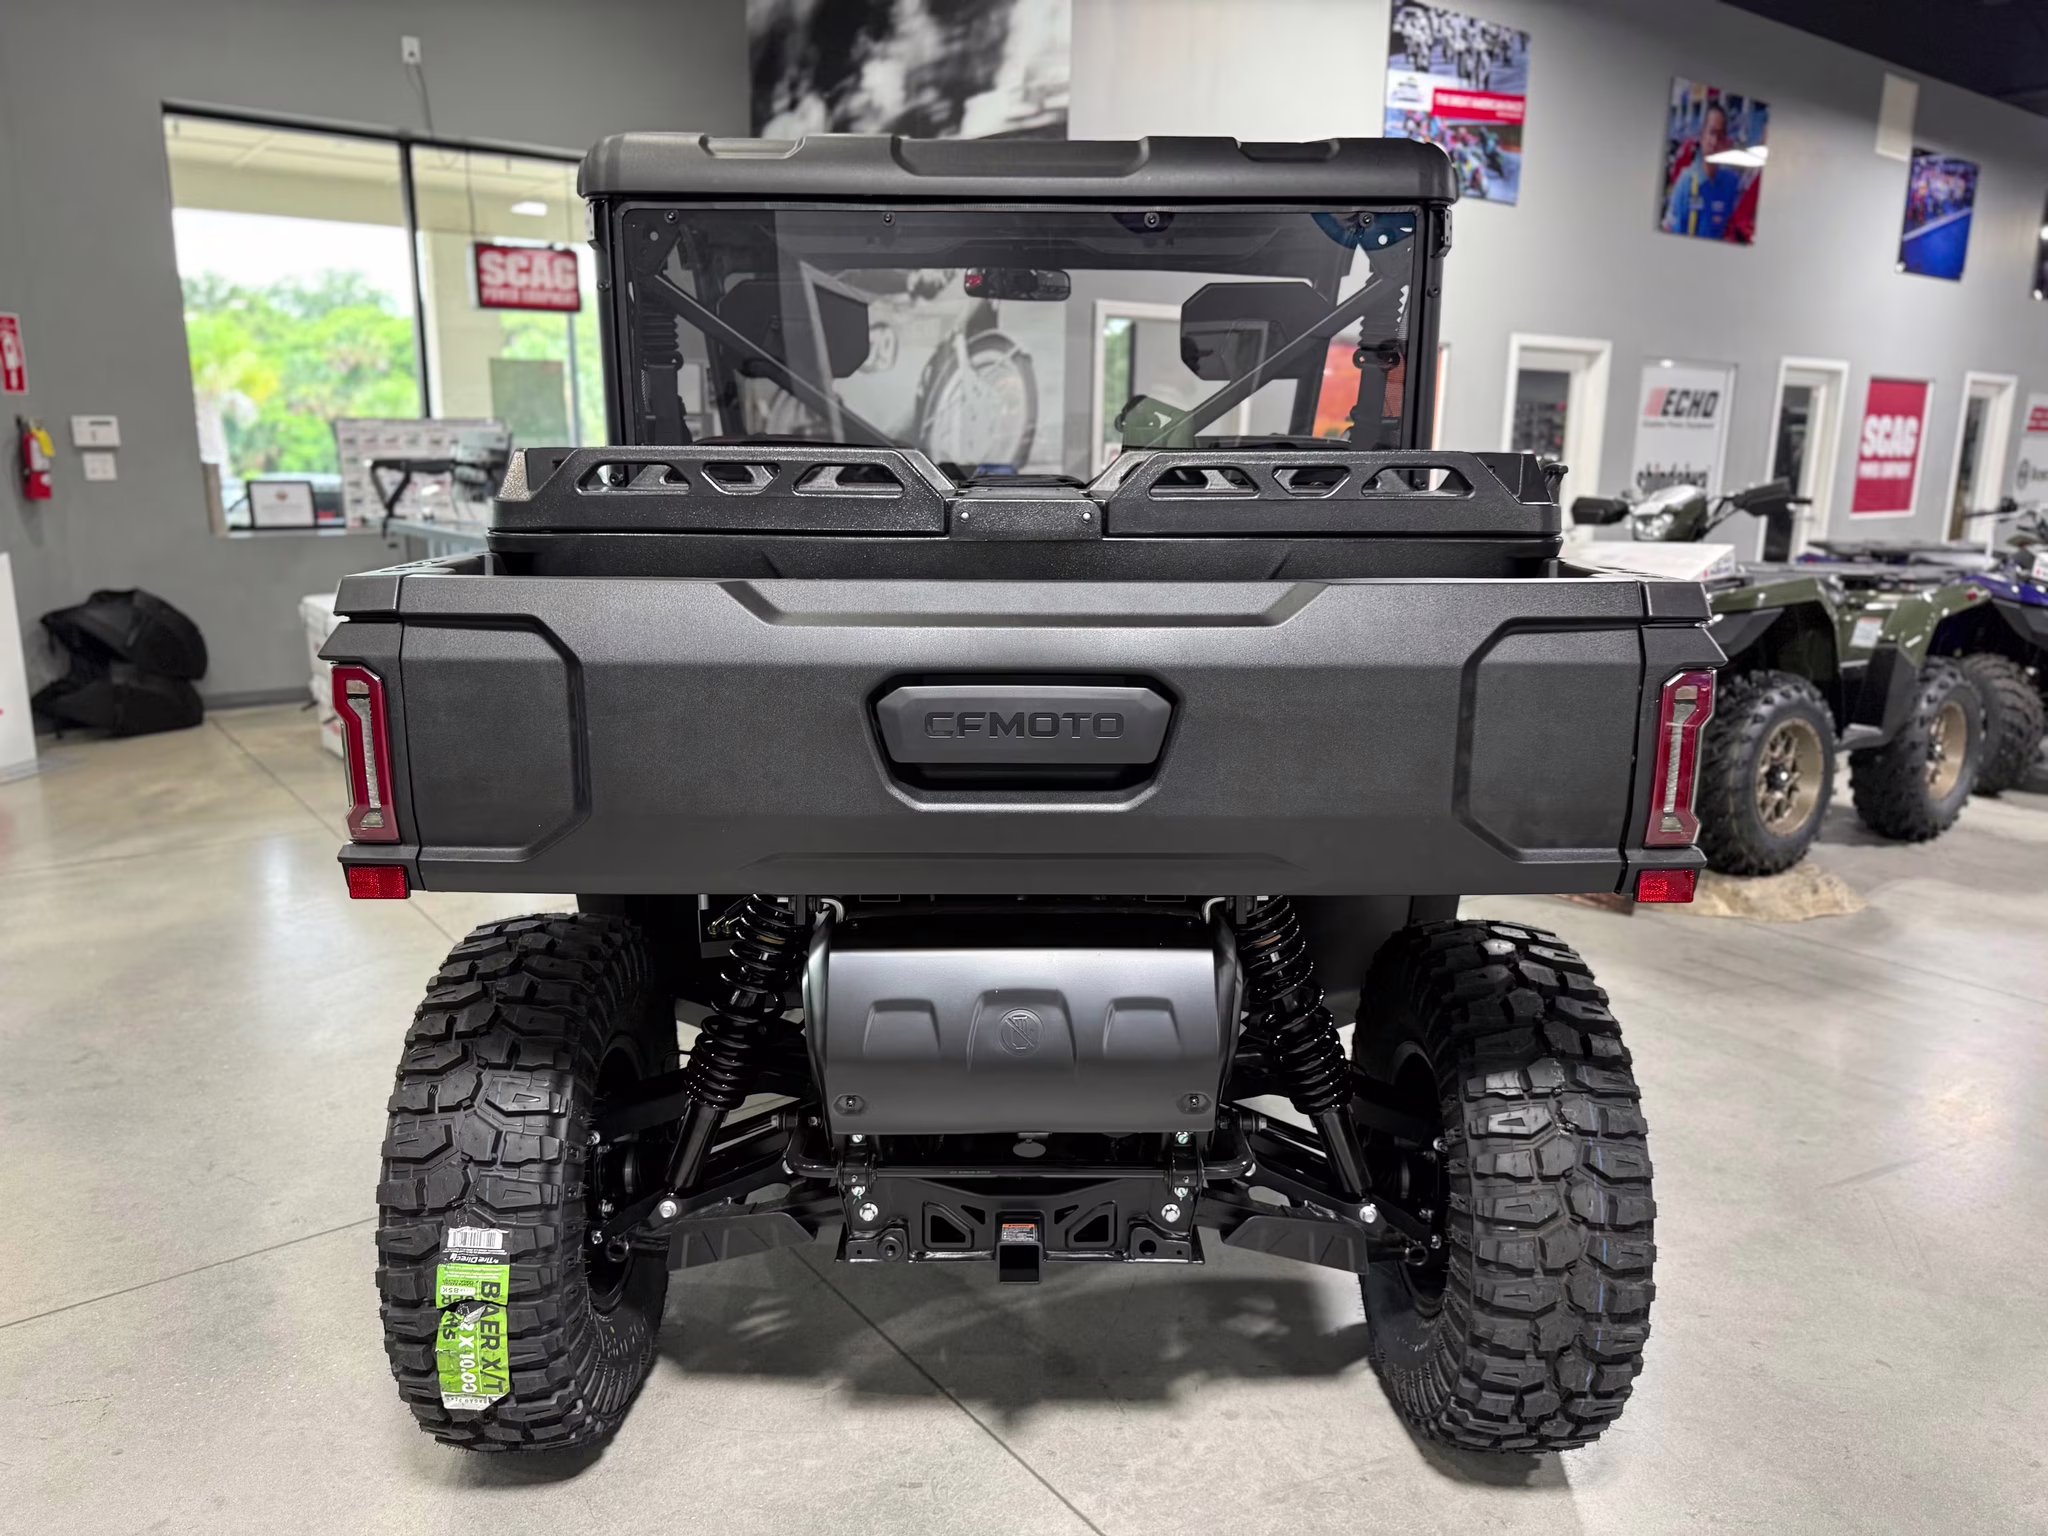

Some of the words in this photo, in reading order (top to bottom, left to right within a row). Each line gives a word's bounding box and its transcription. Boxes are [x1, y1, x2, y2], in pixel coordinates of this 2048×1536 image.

[480, 250, 577, 291] SCAG
[1661, 388, 1719, 418] ECHO
[1861, 413, 1919, 458] SCAG
[924, 711, 1125, 739] CFMOTO
[458, 1335, 475, 1349] X
[459, 1352, 478, 1393] 10.00
[480, 1357, 506, 1393] X/T
